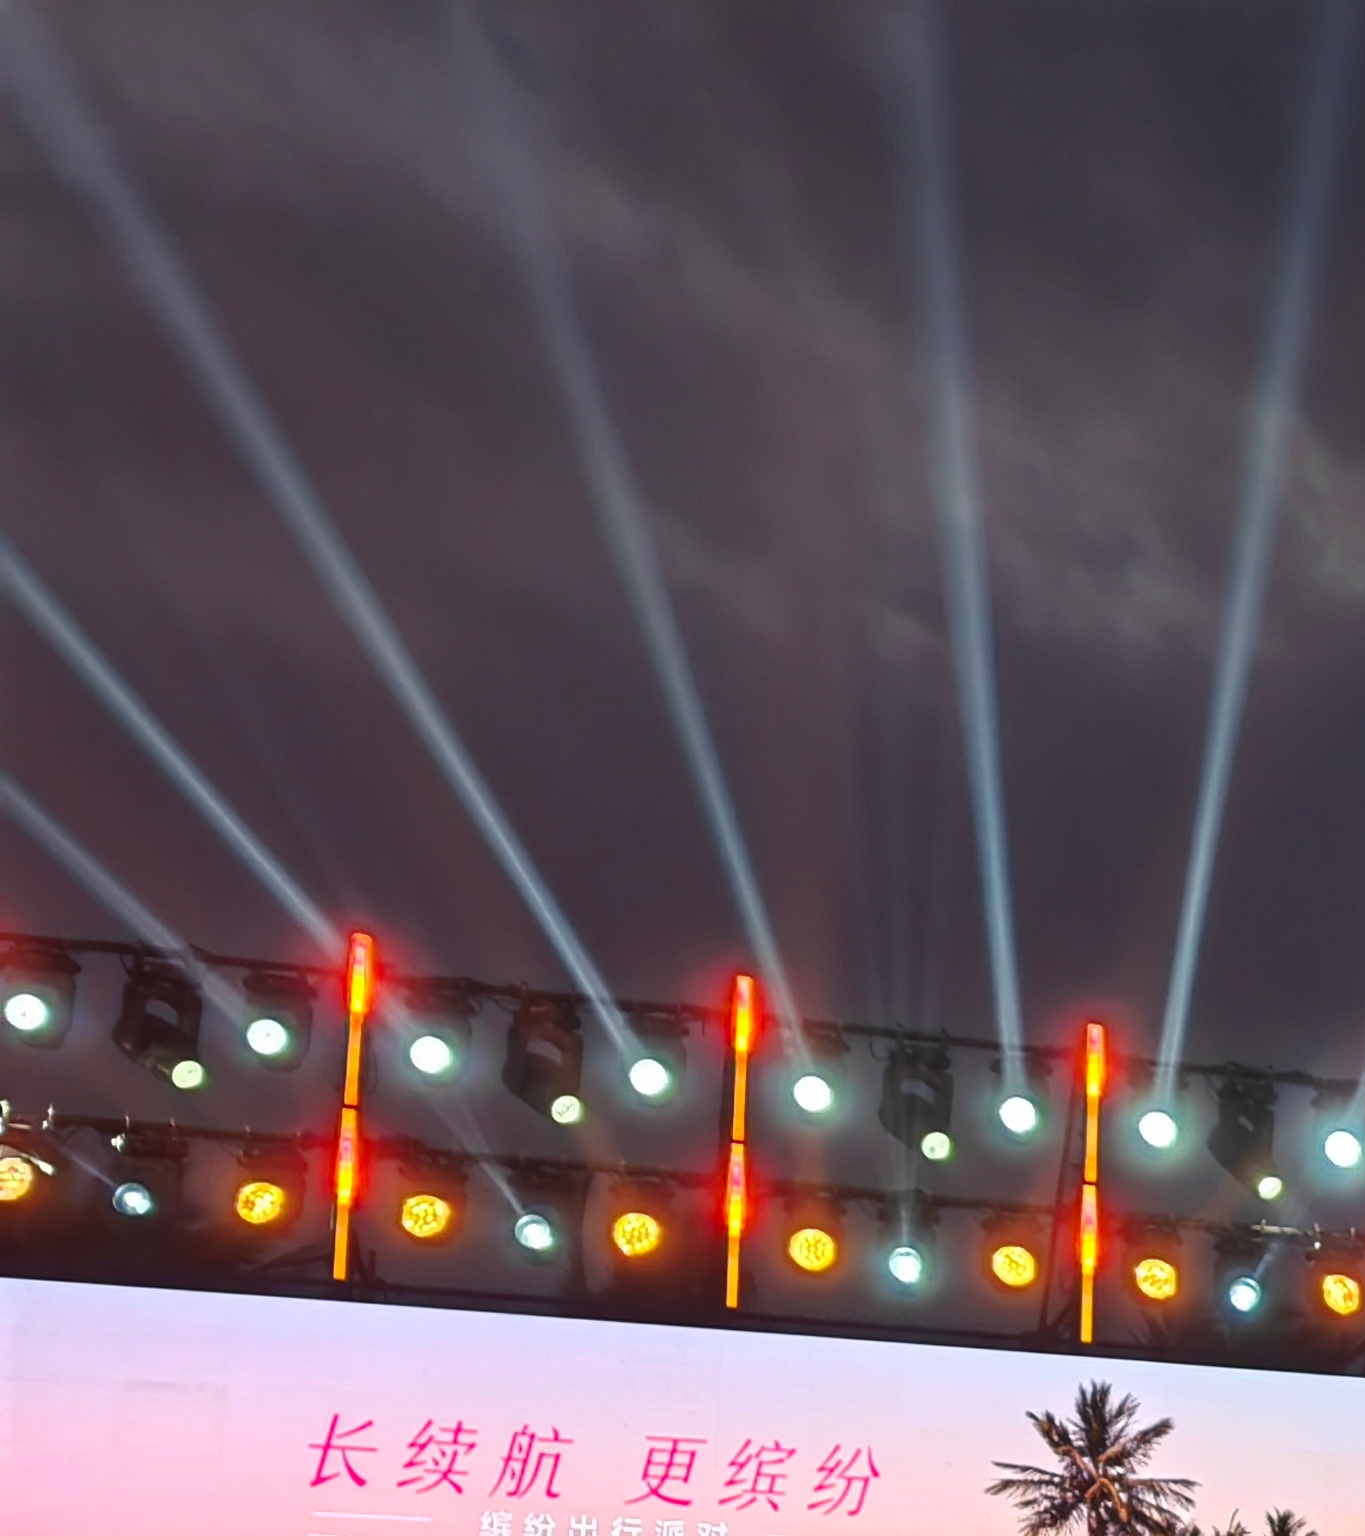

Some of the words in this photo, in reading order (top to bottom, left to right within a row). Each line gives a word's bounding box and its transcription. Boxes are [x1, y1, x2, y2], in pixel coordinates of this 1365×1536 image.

[308, 1413, 574, 1499] 长续航
[624, 1436, 881, 1518] 更缤纷
